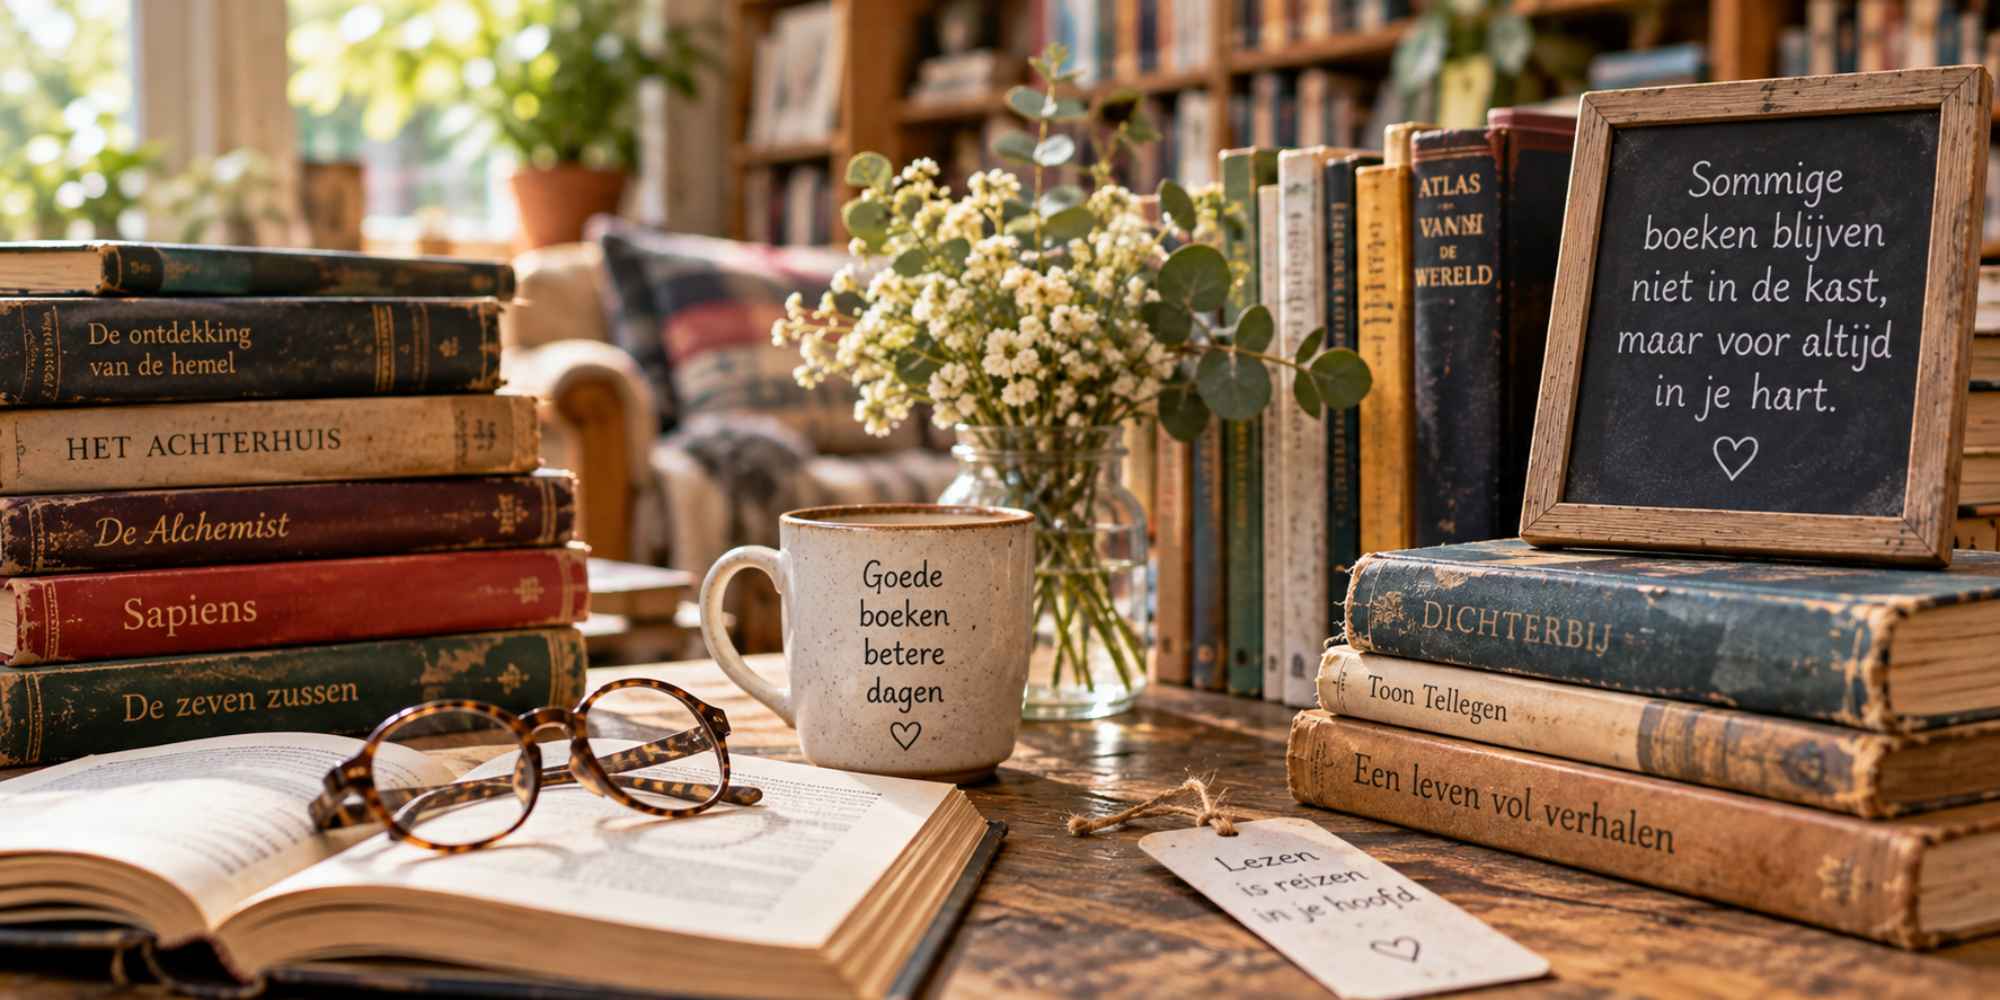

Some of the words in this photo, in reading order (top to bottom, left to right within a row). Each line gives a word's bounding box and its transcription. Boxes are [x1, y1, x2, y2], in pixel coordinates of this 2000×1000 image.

[1418, 172, 1482, 198] ATLAS
[1688, 160, 1844, 208] Sommige
[1439, 246, 1457, 260] DE
[1643, 213, 1758, 250] boeken
[1772, 211, 1885, 262] blijven
[1414, 265, 1493, 288] WERELD
[1631, 269, 1693, 302] niet
[1707, 270, 1738, 302] in
[1751, 265, 1791, 302] de
[1804, 264, 1888, 308] kast,
[88, 323, 121, 345] De
[128, 320, 252, 349] ontdekking
[1617, 330, 1703, 355] maar
[1716, 331, 1791, 356] voor
[1801, 318, 1893, 372] altijd
[89, 359, 130, 378] van
[138, 352, 166, 376] de
[171, 351, 236, 376] hemel
[1654, 373, 1686, 407] in
[1694, 375, 1731, 422] je
[1750, 372, 1837, 413] hart.
[66, 435, 131, 461] HET
[146, 428, 342, 458] ACHTERHUIS
[94, 518, 136, 548] De
[144, 511, 291, 545] Alchemist
[862, 559, 944, 594] Goede
[122, 594, 259, 637] Sapiens
[859, 598, 950, 628] boeken
[1421, 600, 1613, 656] DICHTERBIJ
[864, 637, 946, 666] betere
[121, 693, 164, 723] De
[176, 692, 258, 718] zeven
[267, 681, 360, 712] zussen
[866, 676, 945, 714] dagen
[1366, 674, 1416, 706] Toon
[1422, 683, 1509, 725] Tellegen
[1352, 752, 1401, 793] Een
[1411, 763, 1481, 812] leven
[1491, 787, 1534, 822] vol
[1544, 800, 1676, 855] verhalen
[1214, 848, 1320, 873] Lezen
[1236, 881, 1269, 898] is
[1273, 868, 1370, 894] reizen
[1253, 906, 1292, 925] in
[1295, 901, 1327, 923] je
[1325, 885, 1421, 913] hoofd
